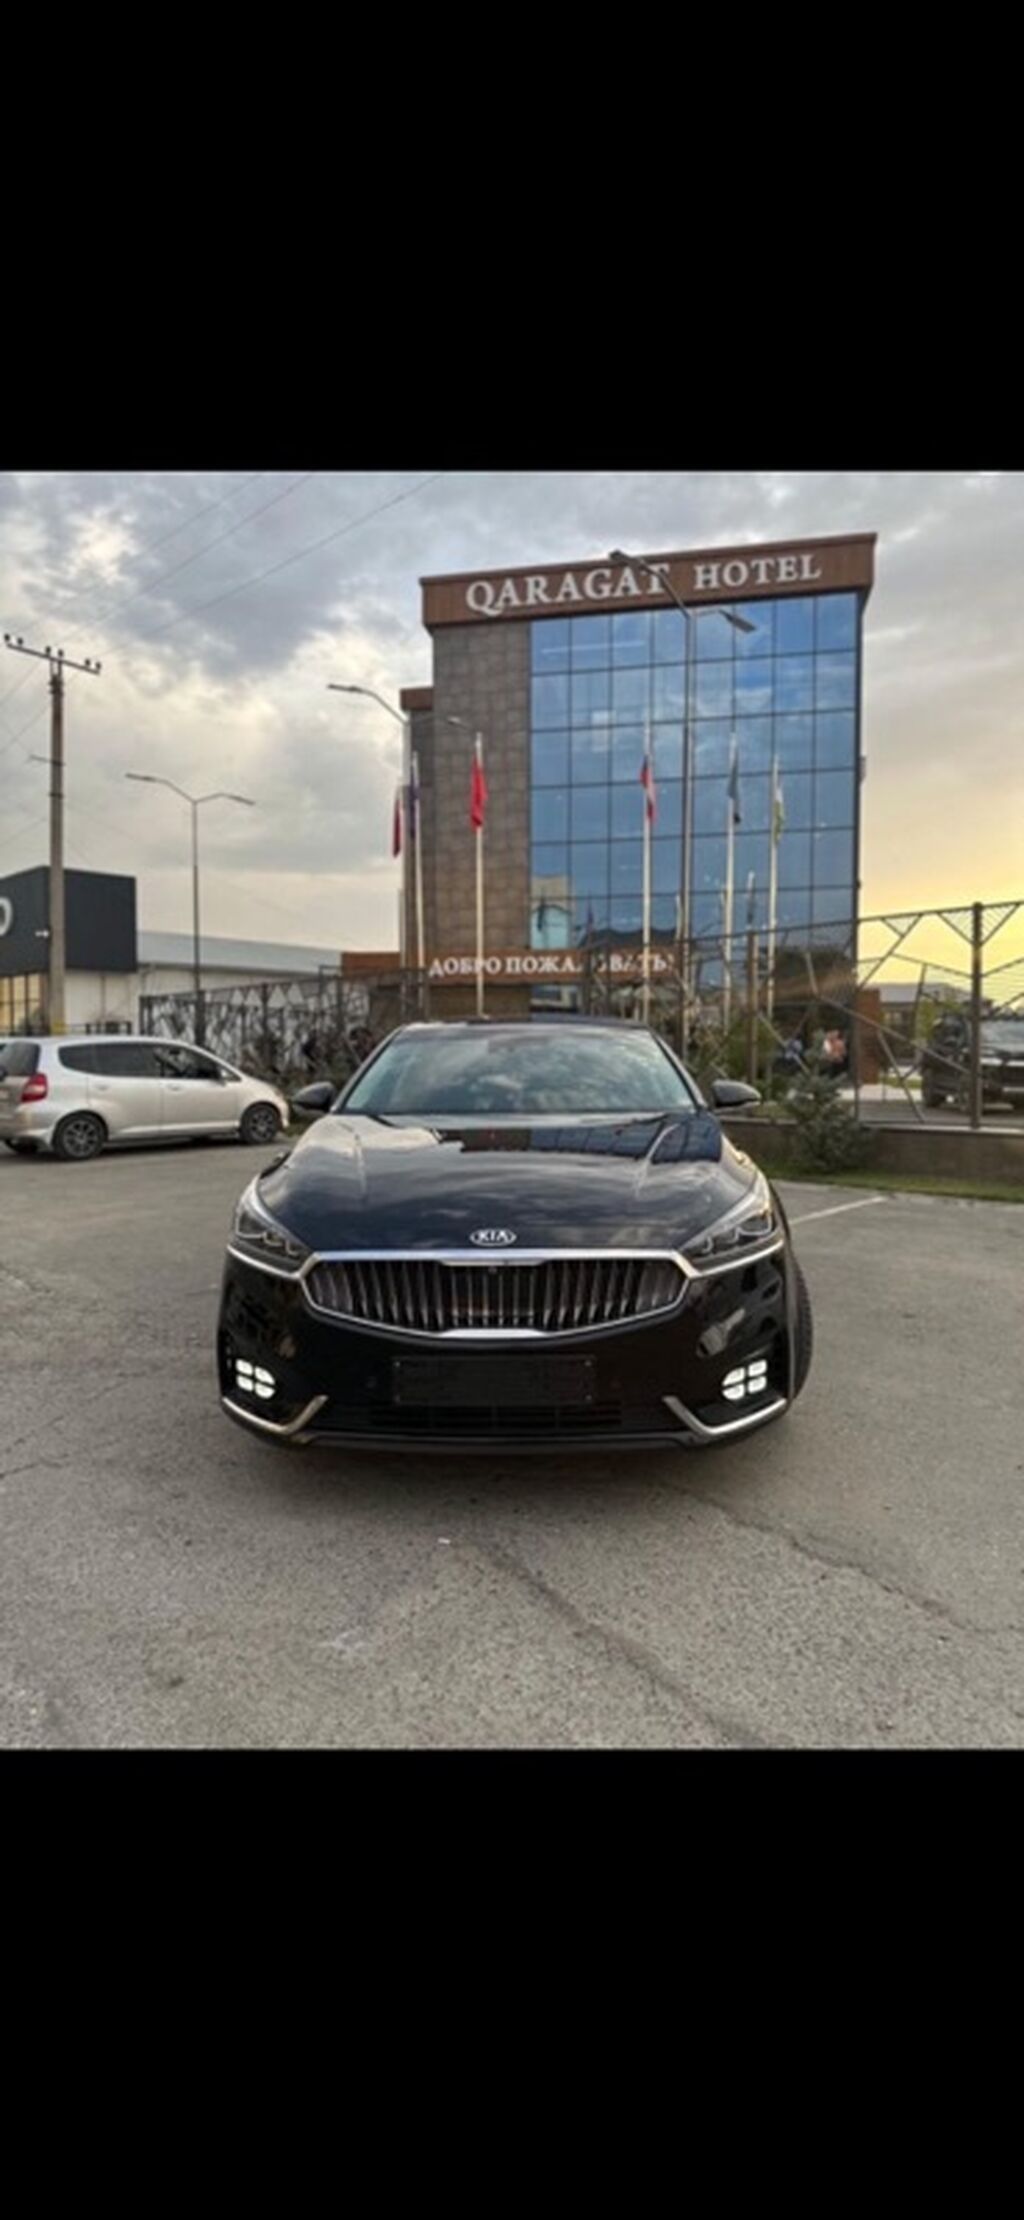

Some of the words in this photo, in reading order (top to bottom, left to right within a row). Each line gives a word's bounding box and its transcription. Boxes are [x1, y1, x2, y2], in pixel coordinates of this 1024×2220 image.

[466, 563, 671, 616] QARAGAT
[693, 554, 822, 590] HOTEL
[428, 956, 502, 978] ДОБРО
[476, 1229, 510, 1243] KIA
